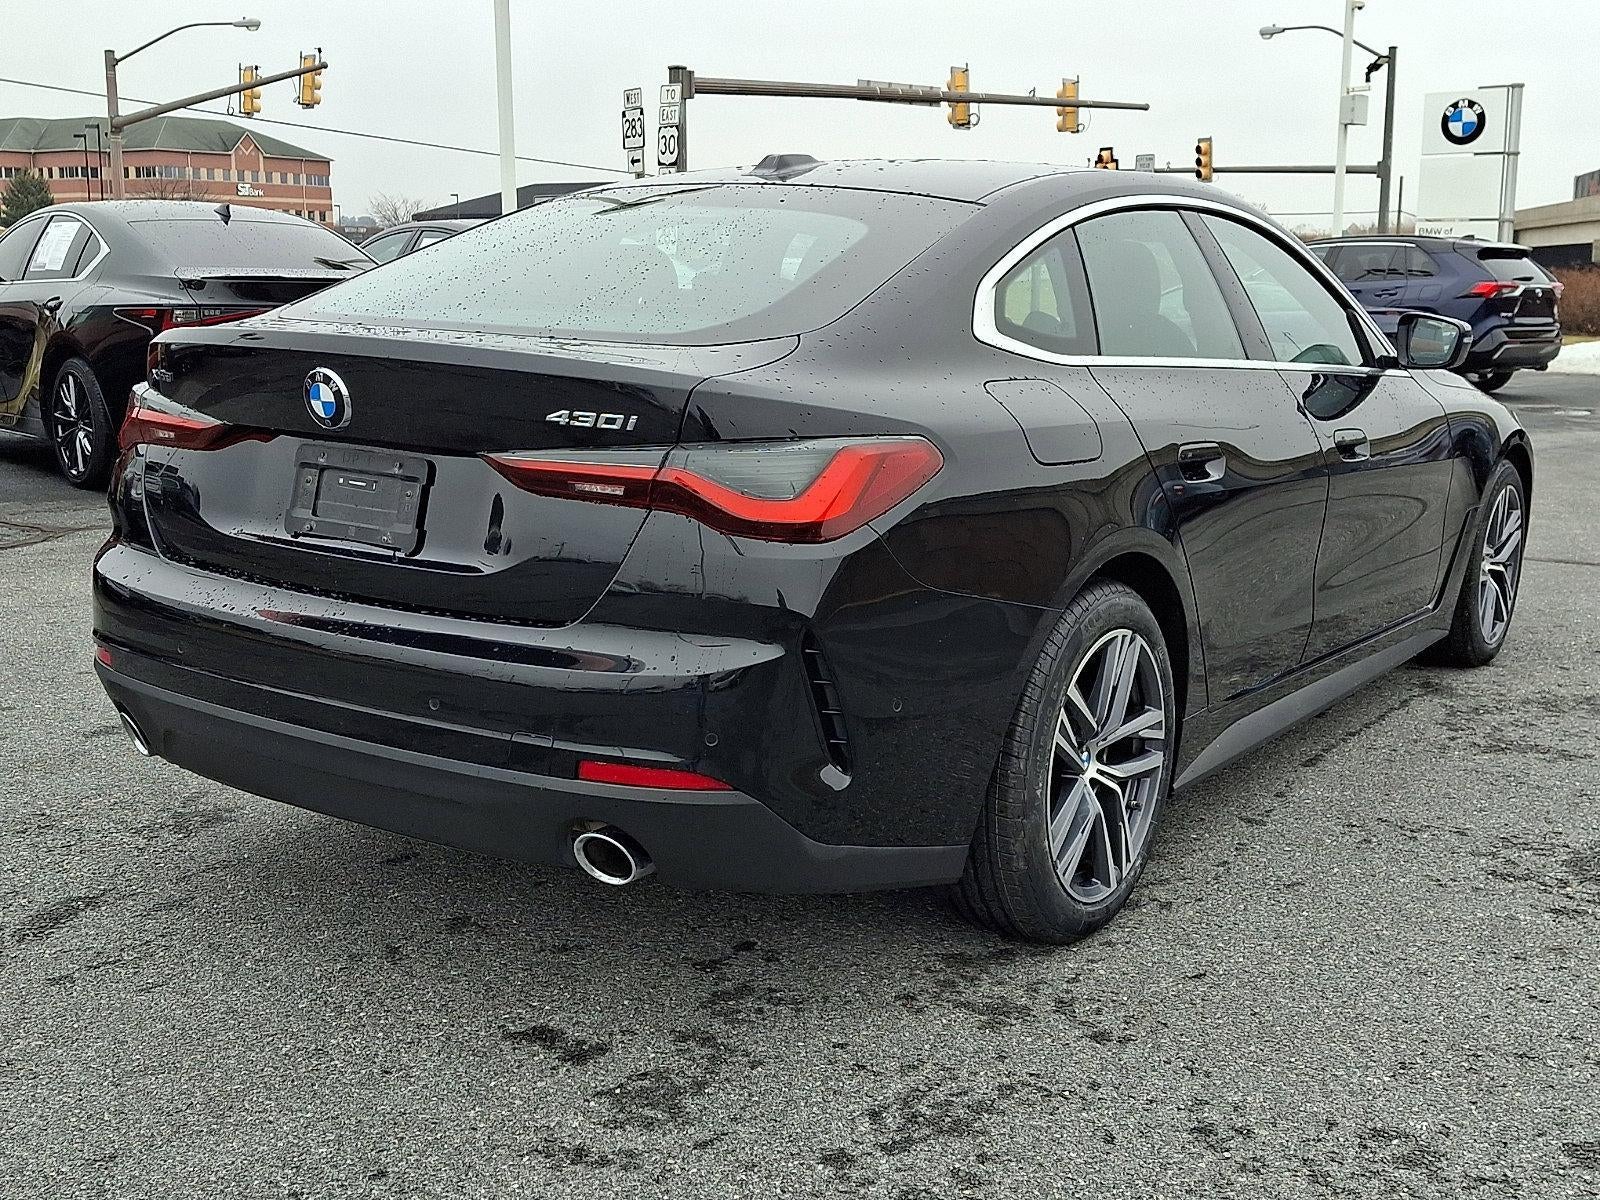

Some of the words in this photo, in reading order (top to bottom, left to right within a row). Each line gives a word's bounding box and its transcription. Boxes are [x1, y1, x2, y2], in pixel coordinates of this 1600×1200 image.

[625, 92, 640, 105] WEST
[666, 89, 676, 100] TO
[662, 109, 677, 121] EAST
[1445, 100, 1483, 116] BMW
[625, 117, 643, 139] 283
[660, 134, 676, 155] 30
[1418, 227, 1443, 236] BMW
[1443, 227, 1454, 236] of
[545, 409, 639, 431] 430i
